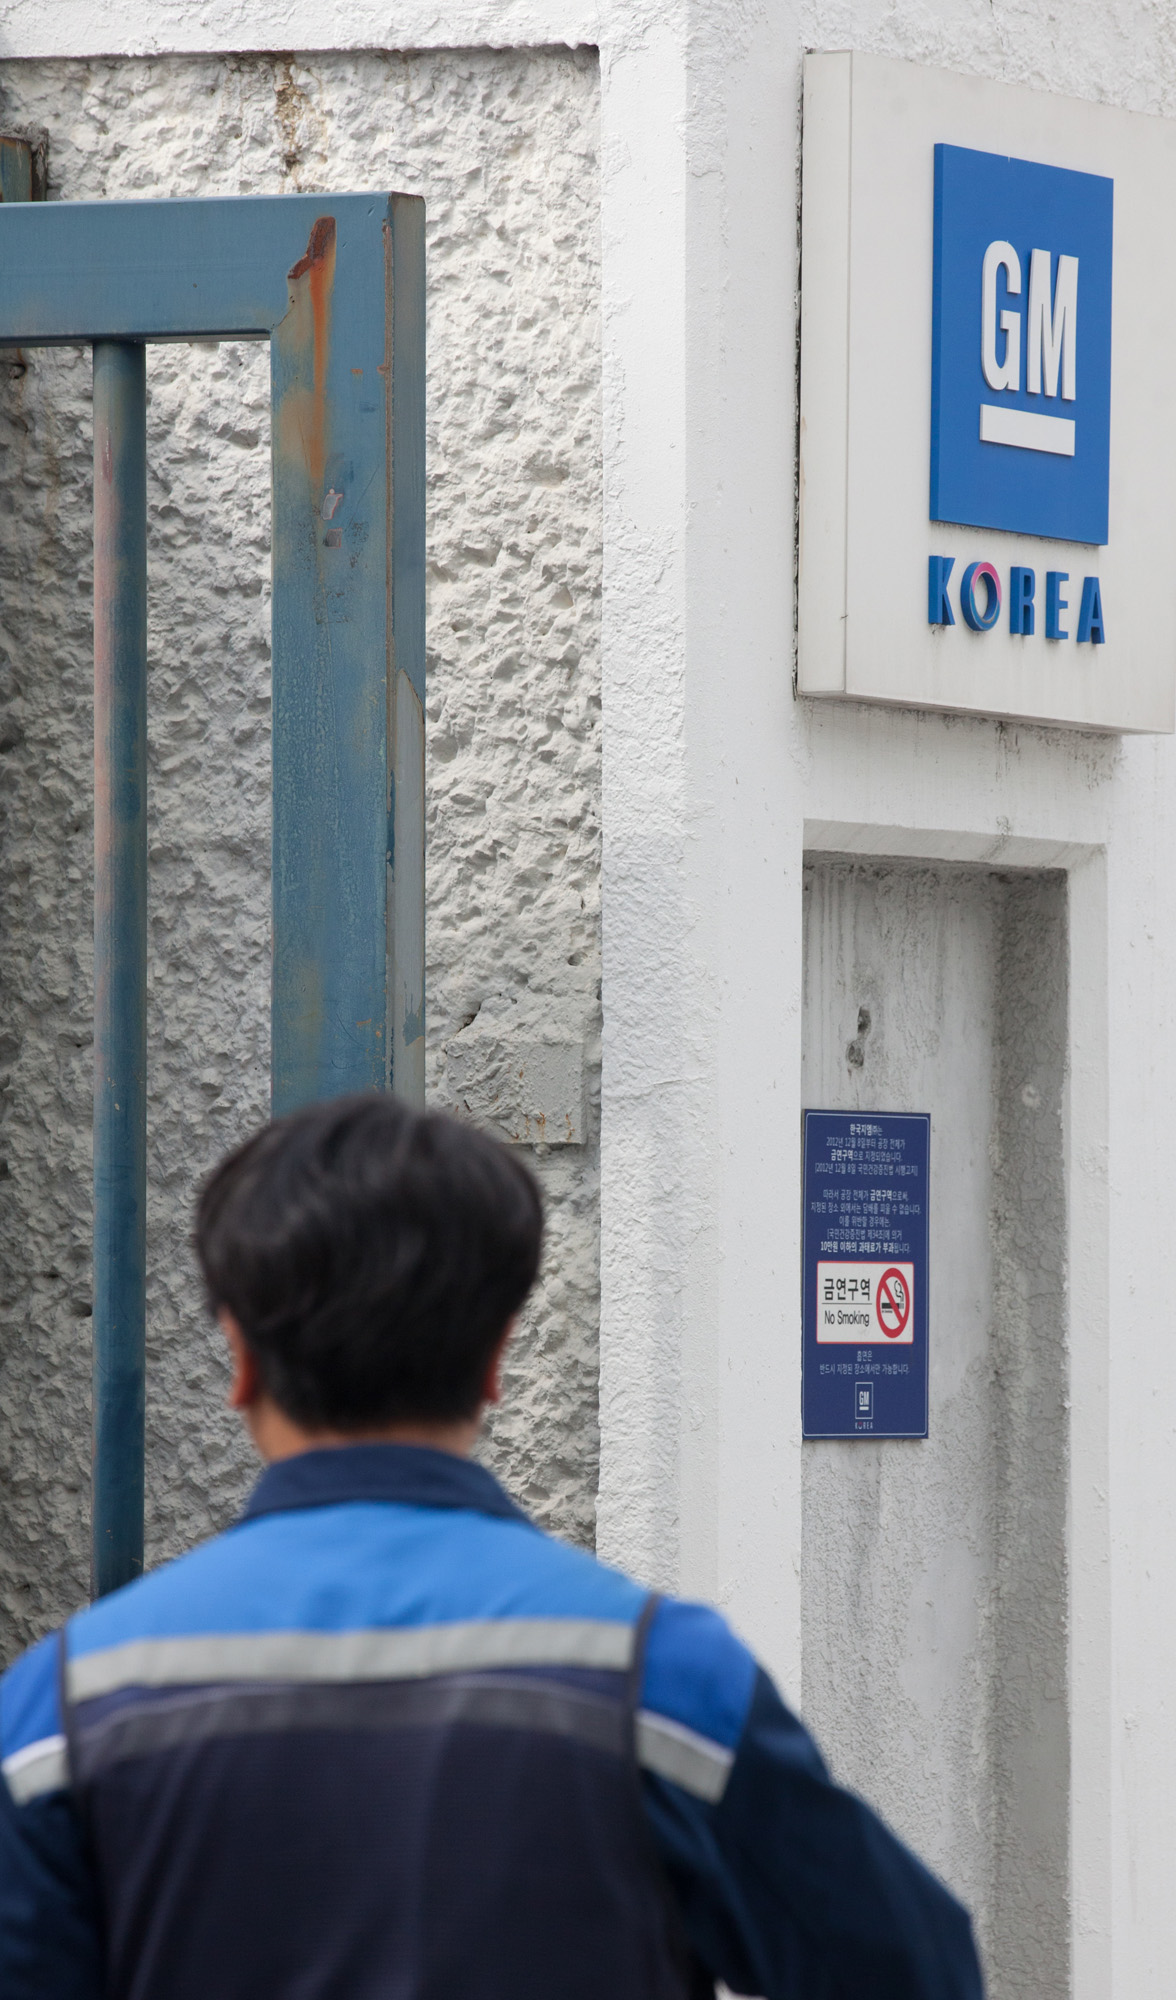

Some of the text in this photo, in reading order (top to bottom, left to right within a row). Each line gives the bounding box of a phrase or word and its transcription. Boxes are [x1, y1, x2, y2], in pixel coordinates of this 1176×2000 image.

[981, 240, 1079, 400] GM
[928, 555, 1105, 644] KOREA
[826, 1137, 906, 1150] 2012년 12월 8일부터 공장 전체가
[831, 1149, 902, 1162] 금연구역으로 지정되었습니다.
[835, 1163, 846, 1174] 12월
[848, 1164, 856, 1174] 8일
[858, 1164, 893, 1175] 국민건강증진법
[823, 1189, 839, 1200] 따라서
[841, 1190, 851, 1200] 공장
[853, 1190, 868, 1200] 전체가
[811, 1202, 920, 1215] 지정된 장소 외에서는 담배를 피울 수 없습니다.
[839, 1216, 849, 1226] 이를
[852, 1216, 867, 1227] 위반할
[892, 1230, 902, 1240] 의거
[821, 1242, 911, 1254] 10만원 이하의 과태료가 부과됩니다.
[824, 1278, 870, 1300] 금연구역
[825, 1311, 869, 1327] No Smoking
[857, 1351, 872, 1362] 흡연은
[820, 1364, 909, 1375] 반드시 지정된 장소에서만 가능합니다.
[859, 1391, 869, 1405] GM
